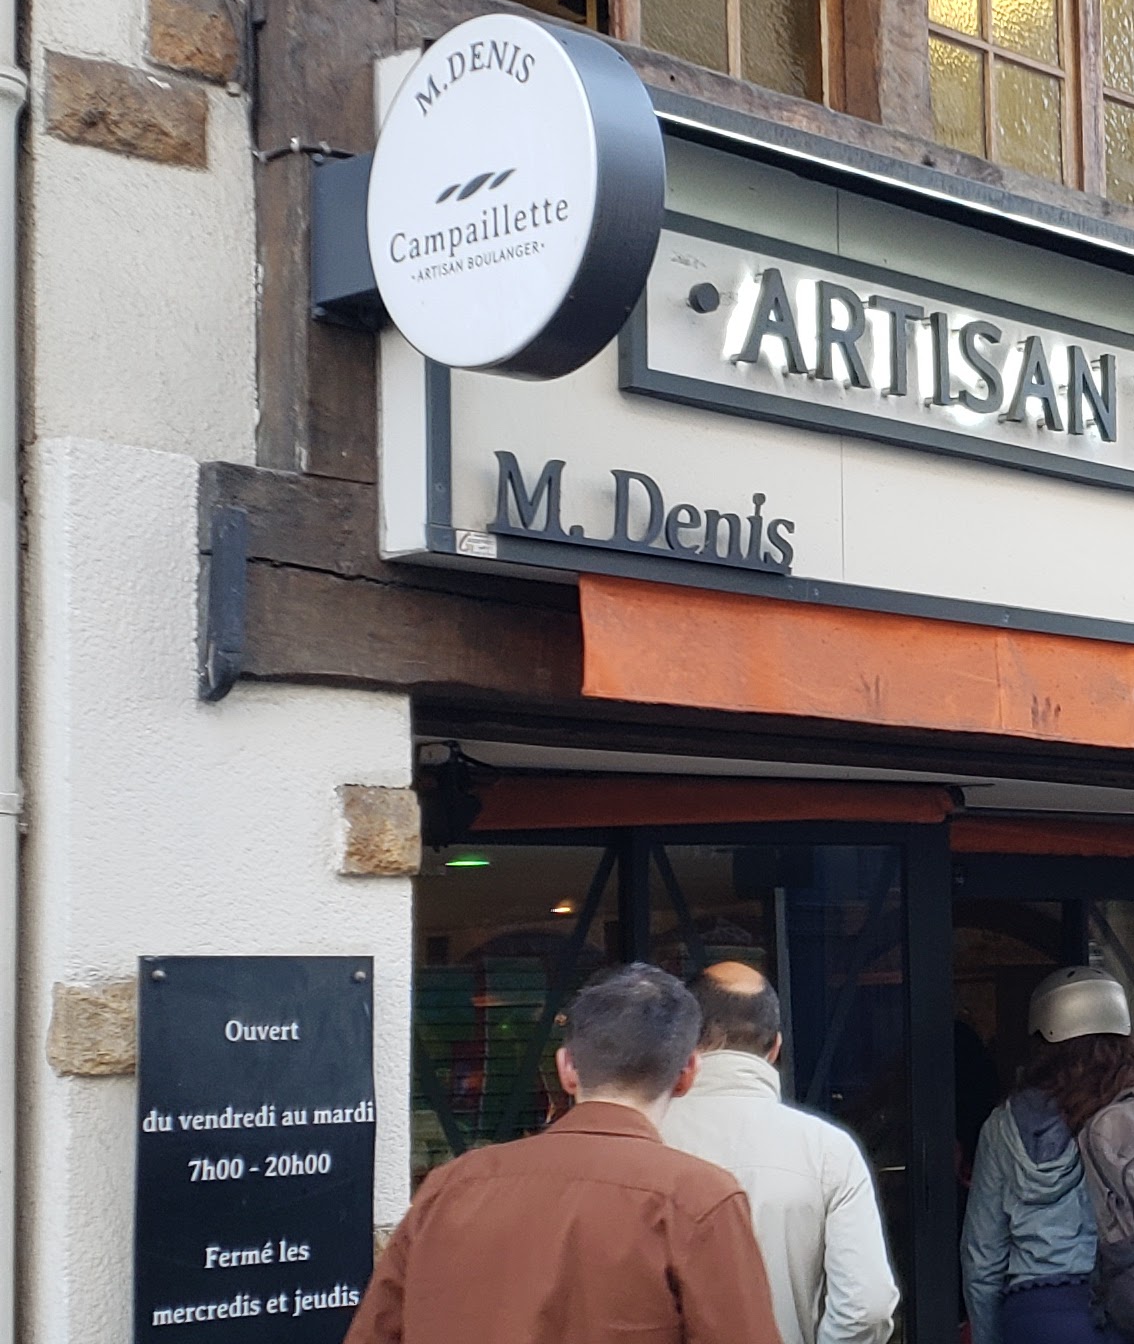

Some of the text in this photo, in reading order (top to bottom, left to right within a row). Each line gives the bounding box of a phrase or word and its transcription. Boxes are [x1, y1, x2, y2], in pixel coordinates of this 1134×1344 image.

[390, 198, 569, 264] Campaillette
[416, 241, 540, 282] ARTISAN BOULANGER
[735, 267, 1117, 443] ARTISAN
[493, 451, 796, 570] M. Denis
[225, 1020, 299, 1042] Ouvert
[142, 1101, 375, 1133] du vendredi au mardi
[187, 1157, 243, 1183] 7h00
[264, 1153, 331, 1178] 20h00
[203, 1241, 310, 1270] Fermé les
[151, 1285, 361, 1327] mercredis et jeudis
